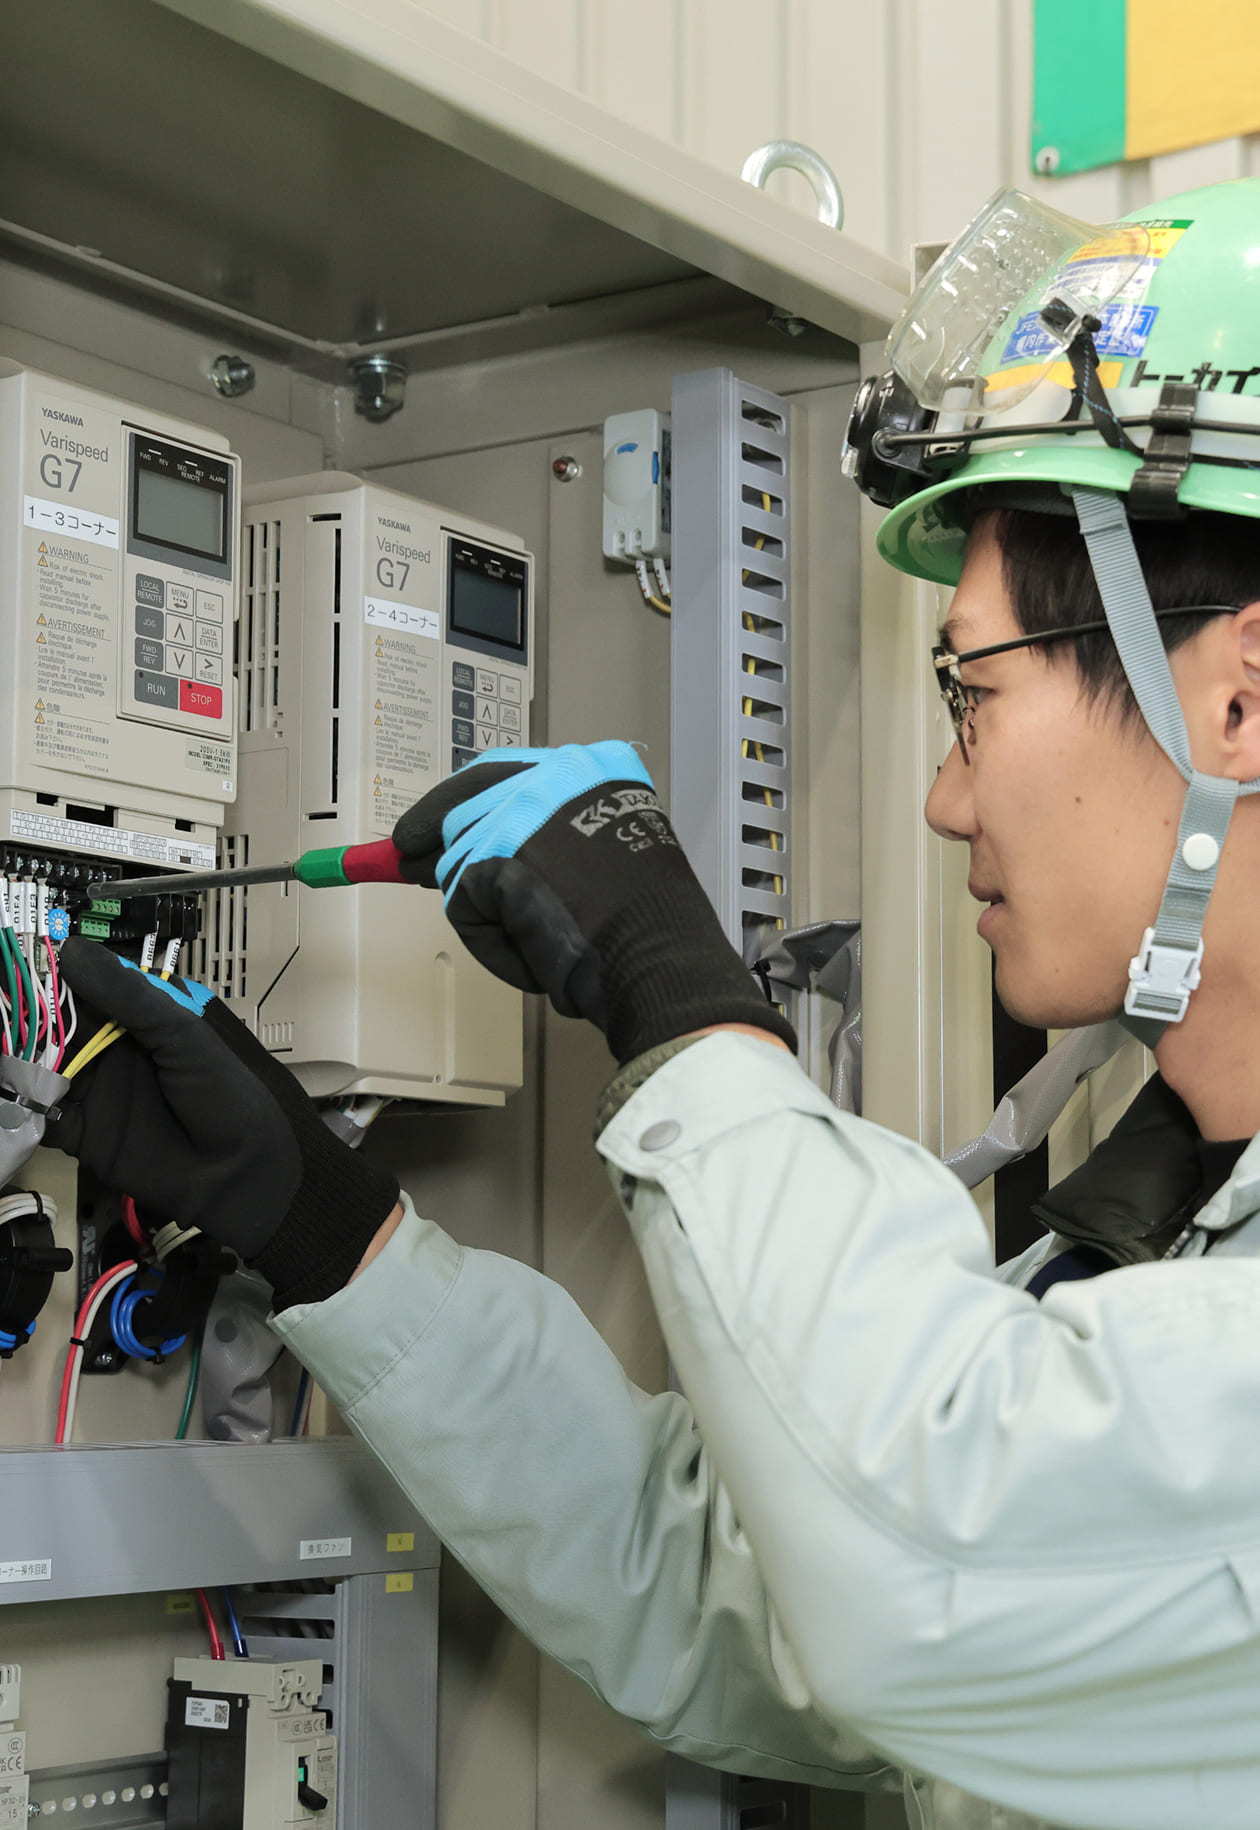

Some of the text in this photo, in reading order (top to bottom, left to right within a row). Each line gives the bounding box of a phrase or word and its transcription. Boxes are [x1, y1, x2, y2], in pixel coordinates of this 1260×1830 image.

[42, 407, 84, 427] YASKAWA
[40, 428, 108, 463] Varispeed
[40, 453, 82, 493] G7
[377, 516, 411, 533] YASKAWA
[50, 545, 89, 564] WARNING
[376, 535, 431, 564] Varispeed
[376, 557, 410, 592] G7
[137, 590, 163, 603] REMOTE
[140, 580, 189, 599] LOCAL MENU
[48, 618, 104, 638] AVERTISSEMENT
[143, 618, 217, 638] JOG DATA
[143, 638, 219, 654] FWD ENTER
[384, 639, 417, 655] WARNING
[143, 655, 218, 681] REV RESET
[147, 683, 212, 705] RUN STOP
[383, 703, 429, 720] AVERTISSEMENT
